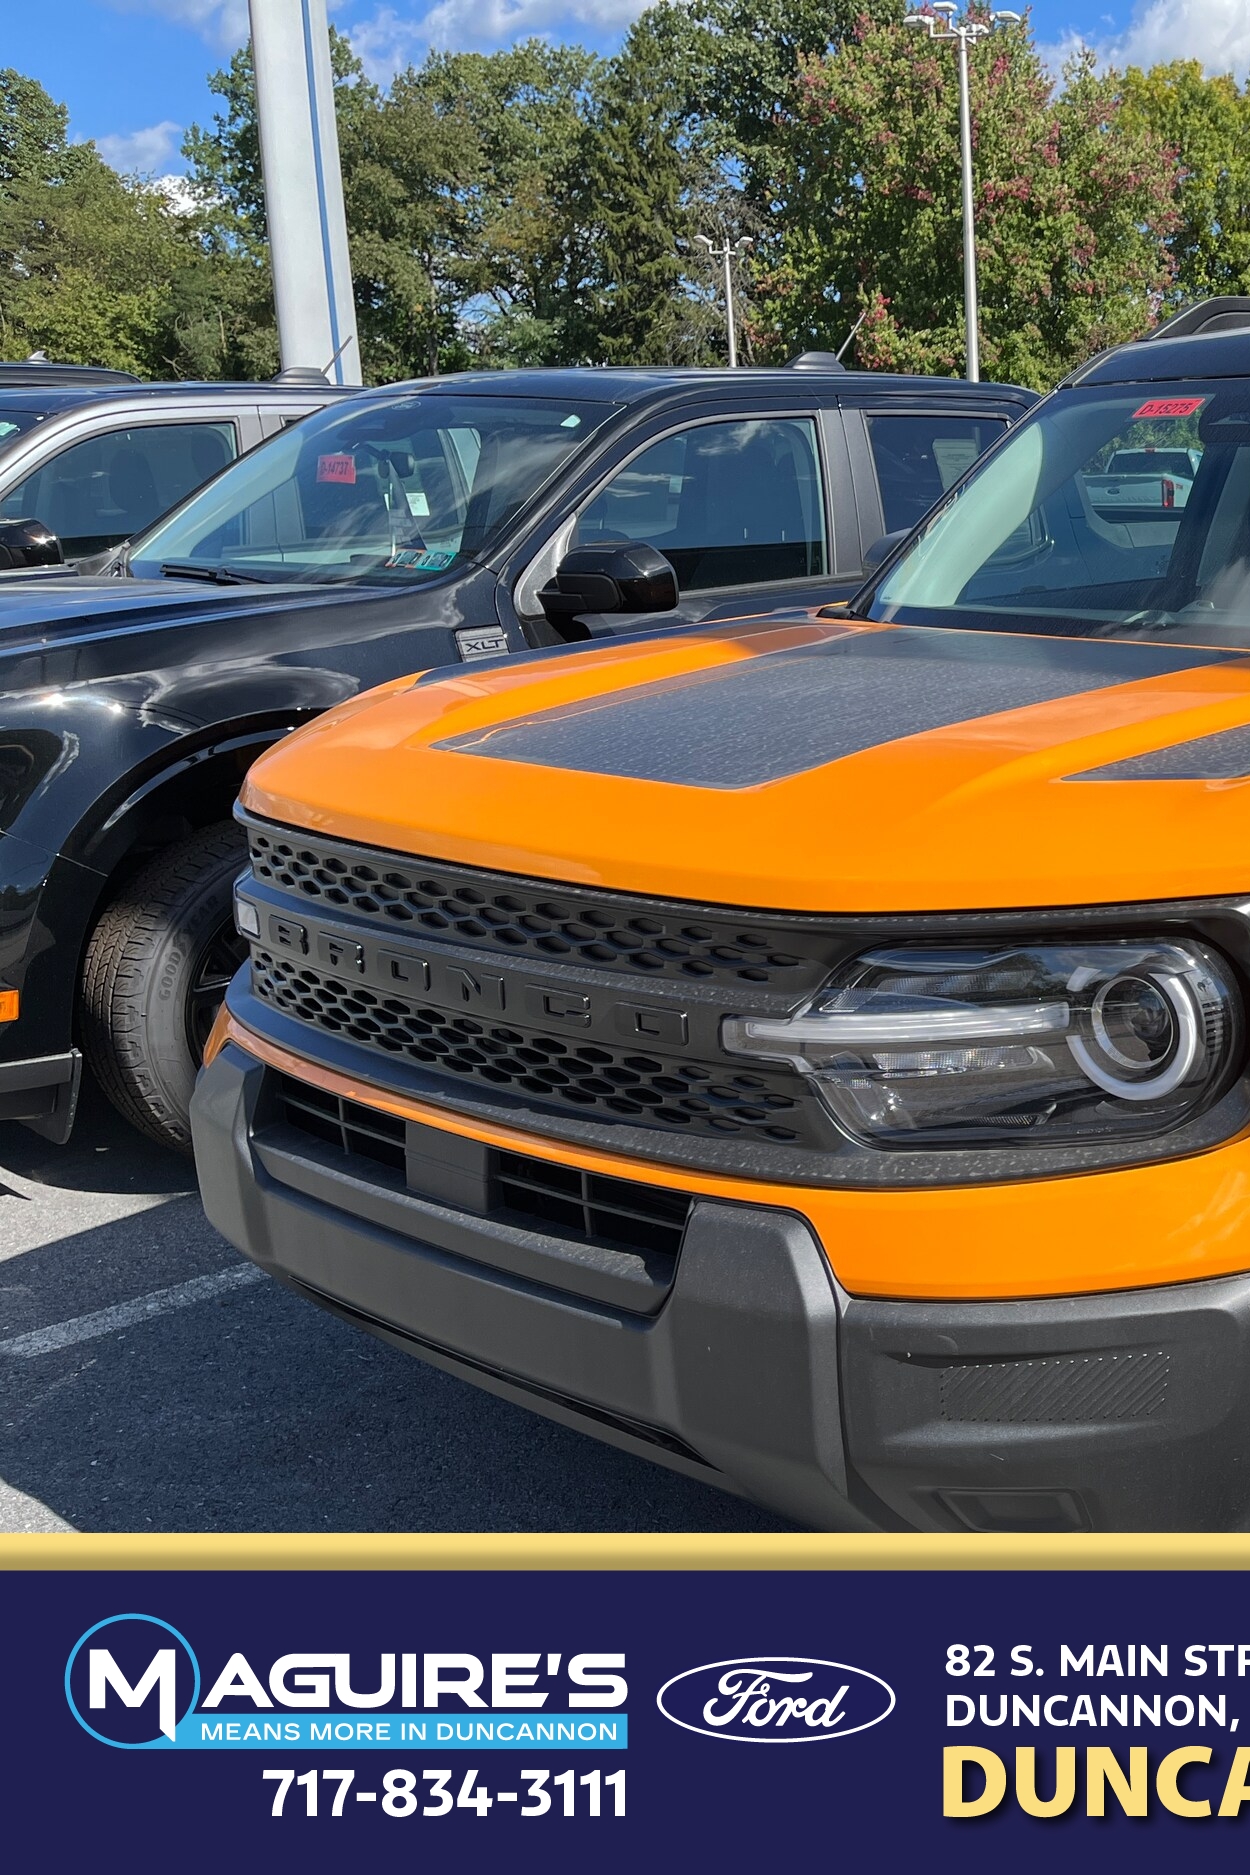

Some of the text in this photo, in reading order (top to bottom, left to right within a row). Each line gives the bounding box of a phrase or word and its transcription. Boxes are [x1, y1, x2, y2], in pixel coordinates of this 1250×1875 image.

[1139, 402, 1193, 415] D-15275
[319, 461, 350, 477] D-14737
[465, 639, 504, 652] XLT
[269, 914, 690, 1046] BRONCO
